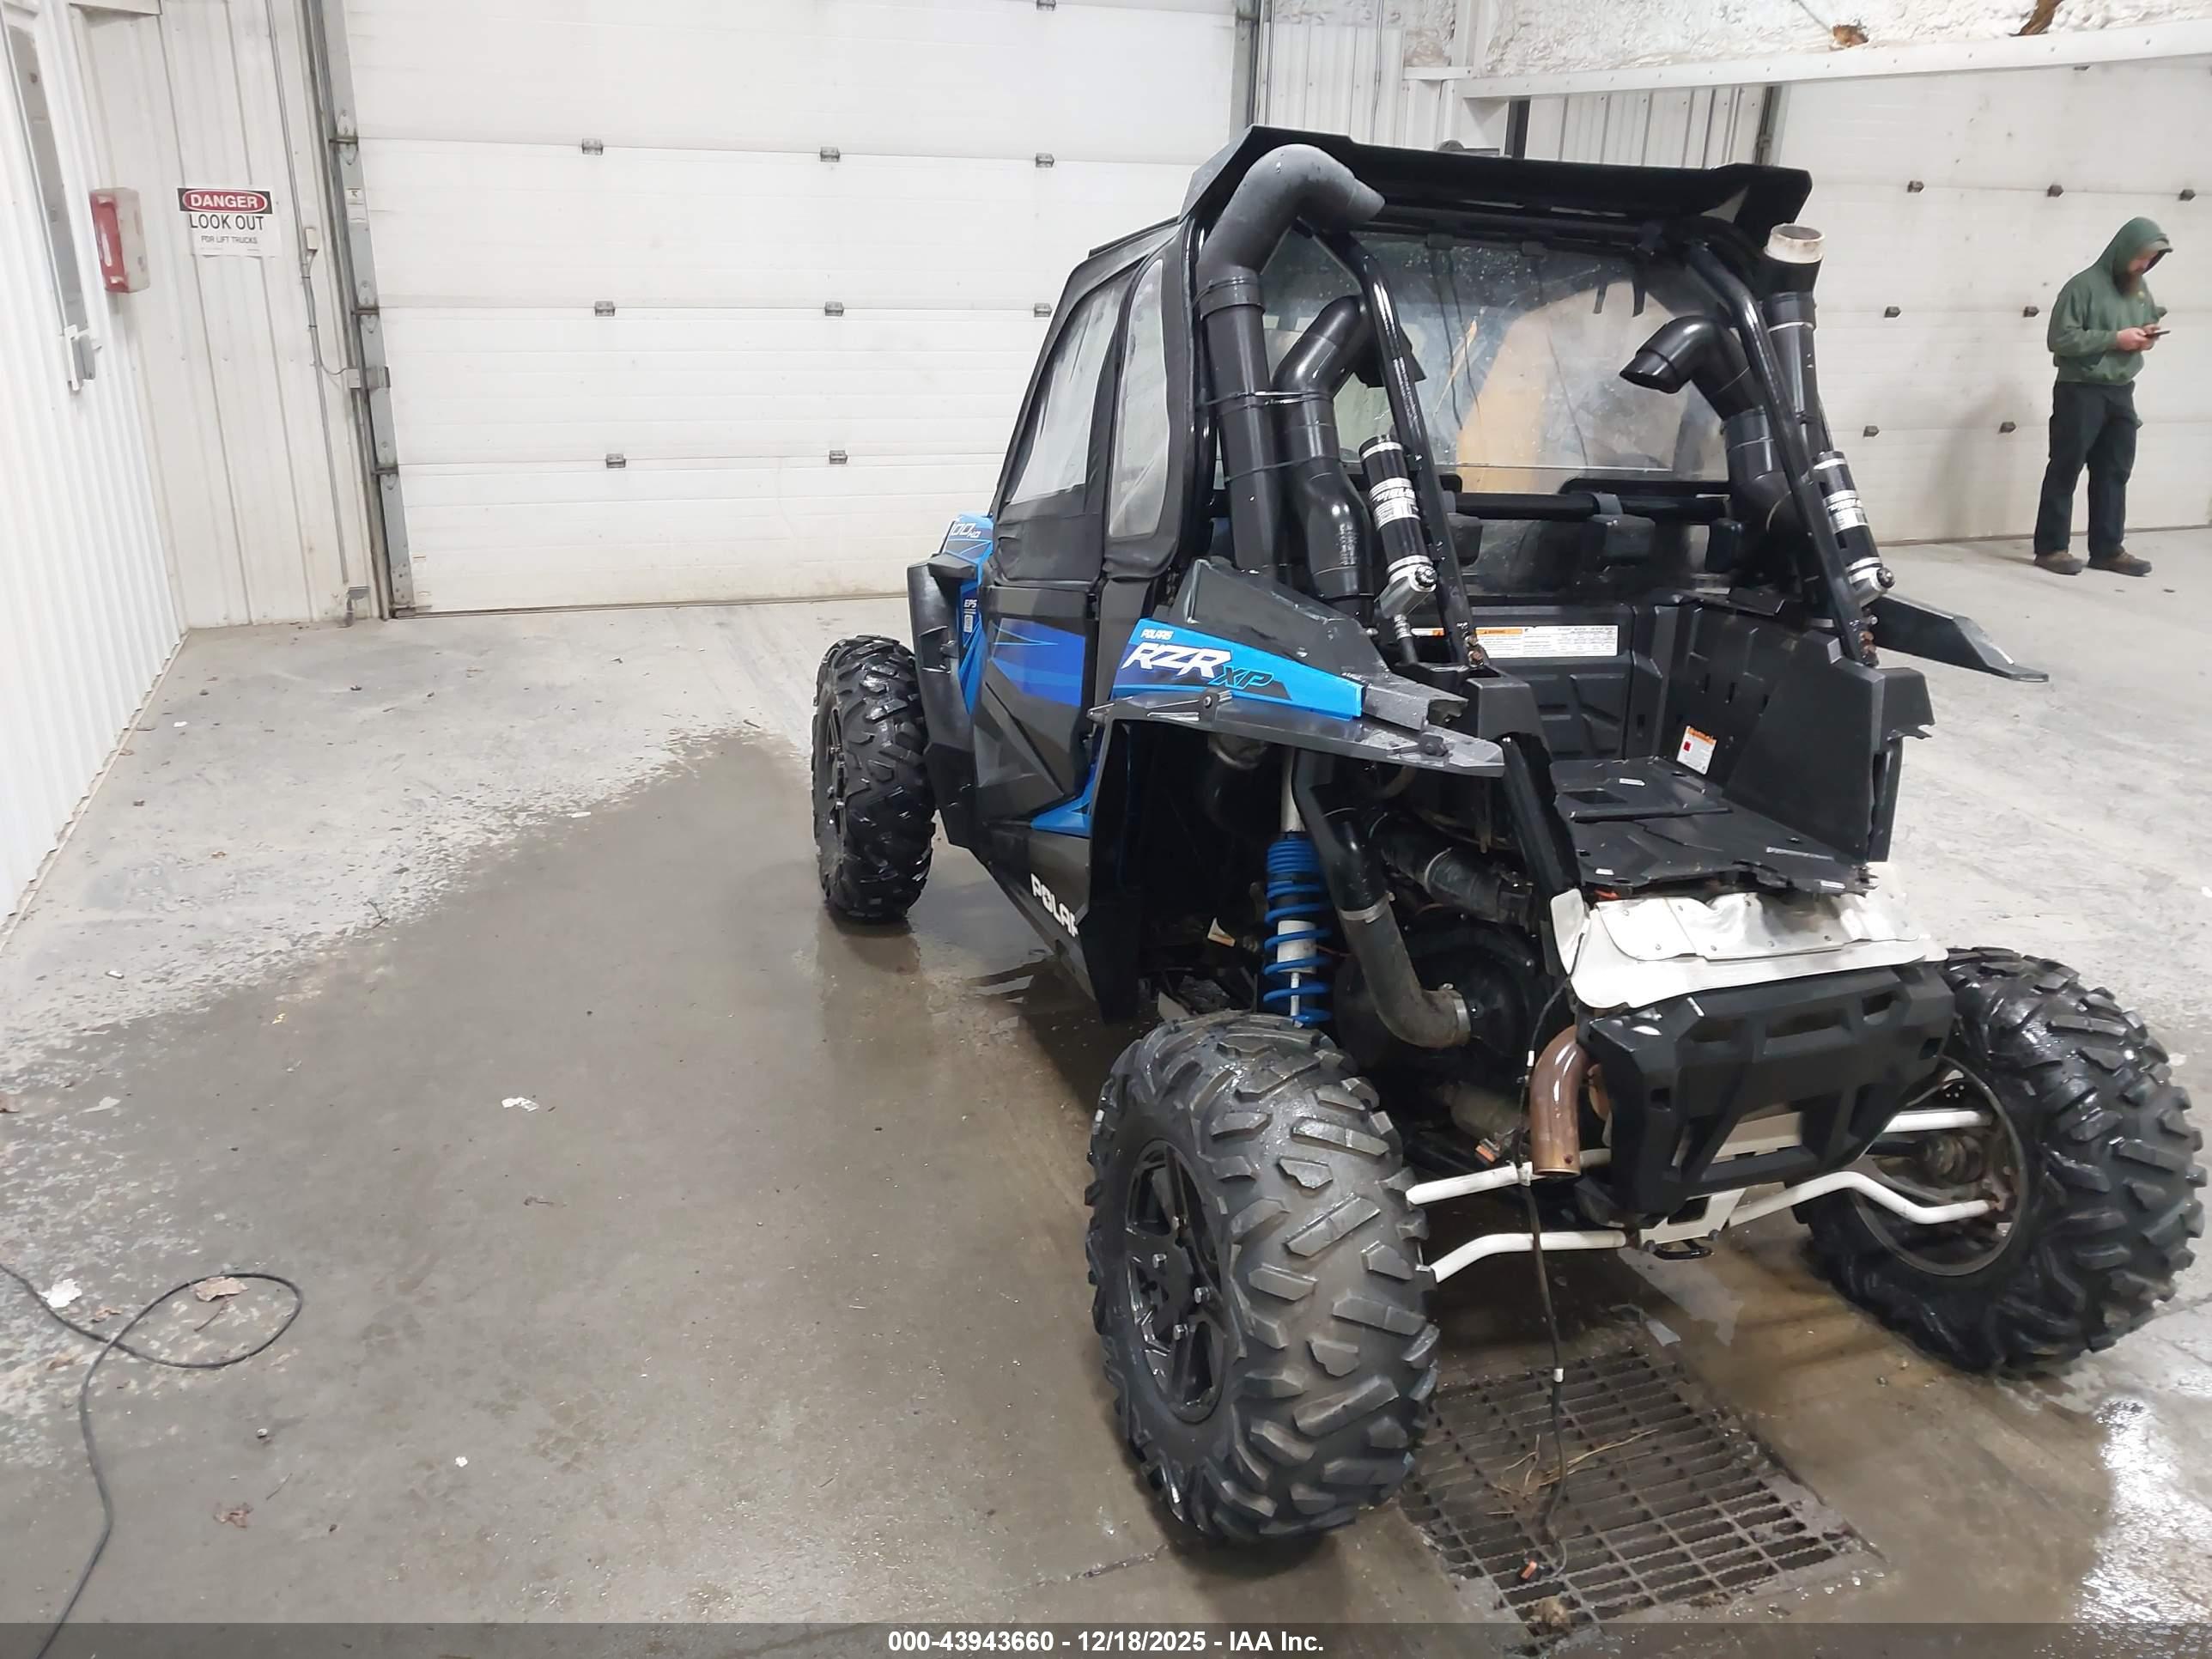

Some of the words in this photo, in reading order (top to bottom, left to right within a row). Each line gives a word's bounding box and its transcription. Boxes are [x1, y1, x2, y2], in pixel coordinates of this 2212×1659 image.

[190, 194, 258, 209] DANGER
[189, 214, 232, 229] LOOK
[234, 215, 264, 230] OUT
[216, 235, 229, 244] LIFT
[231, 236, 258, 245] TRUCKS
[963, 599, 977, 608] EPS
[1140, 629, 1174, 641] POLARIS
[1121, 641, 1231, 679] RZR
[1208, 665, 1274, 690] XP
[1030, 872, 1079, 938] POLAR
